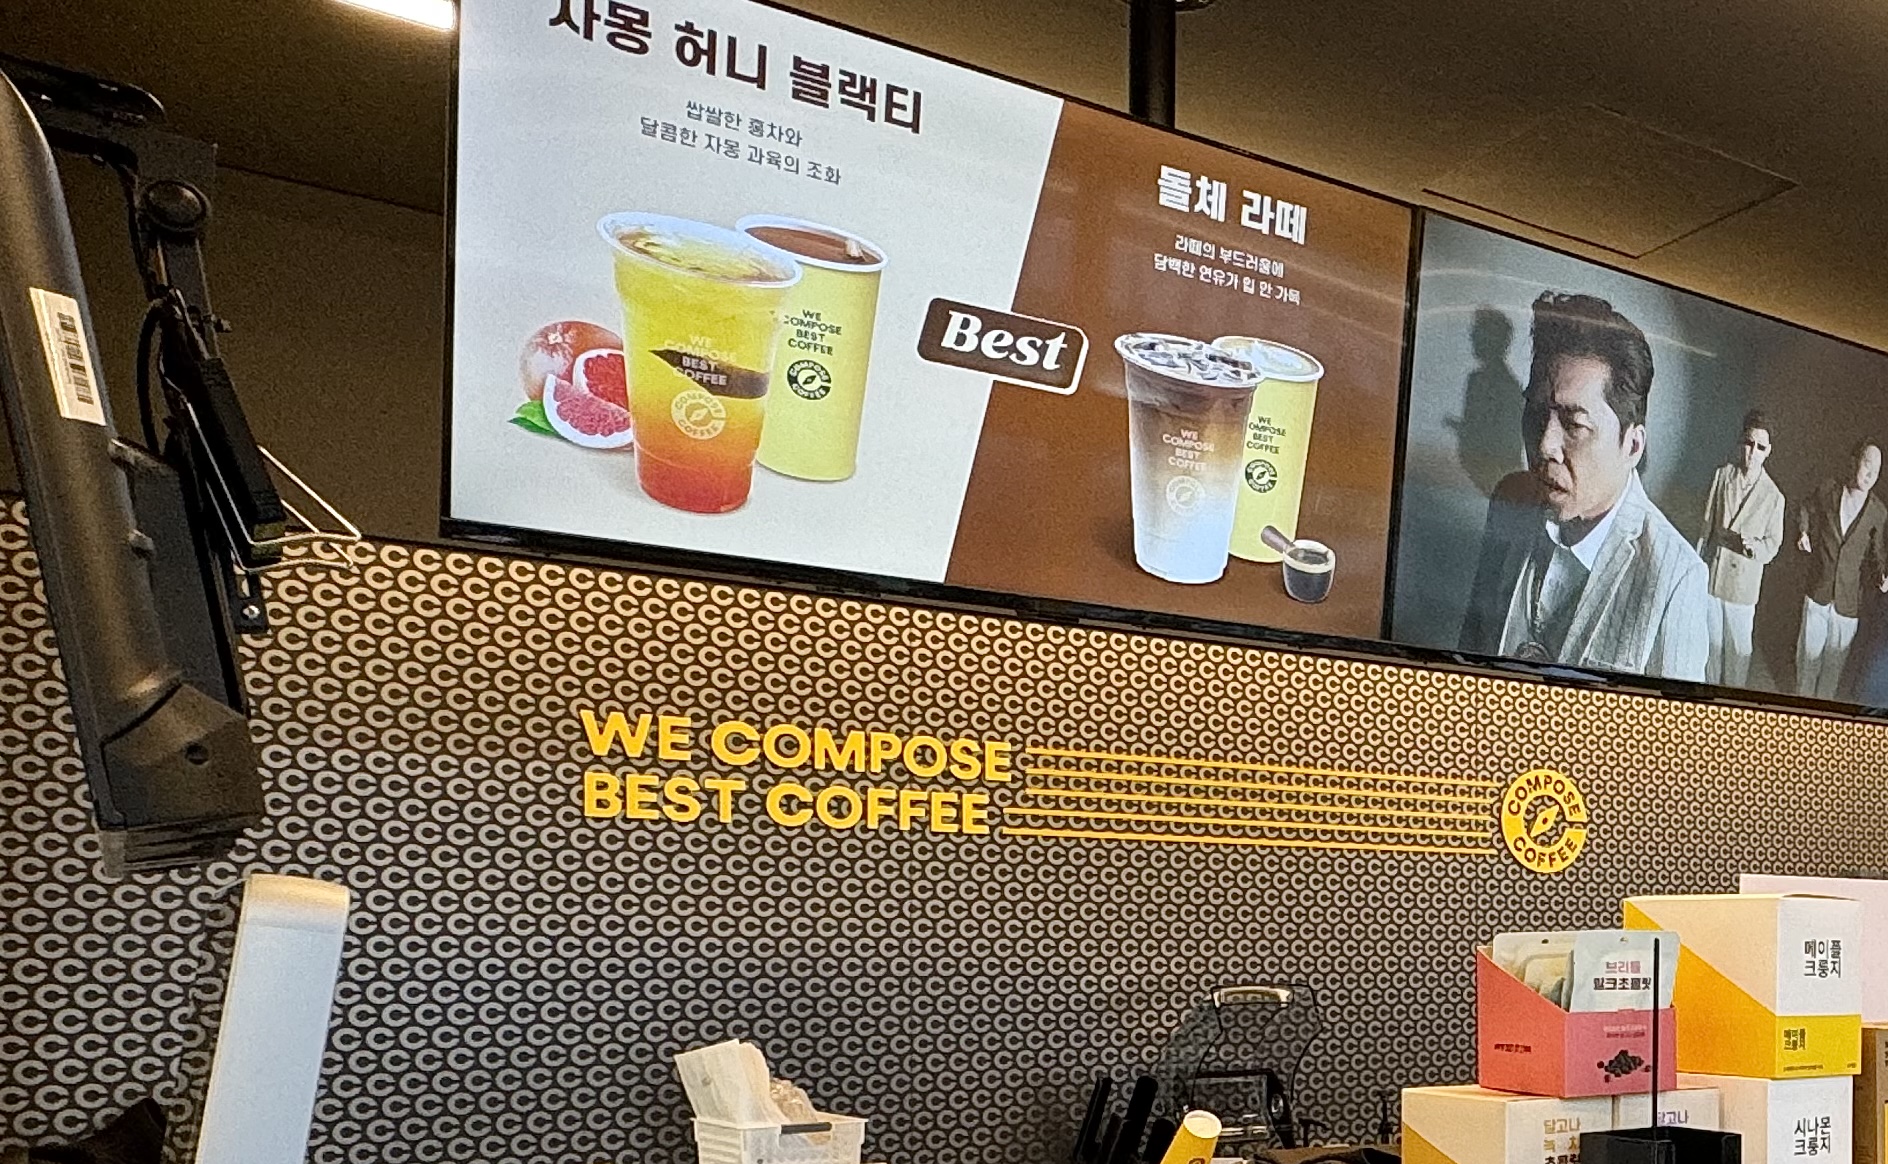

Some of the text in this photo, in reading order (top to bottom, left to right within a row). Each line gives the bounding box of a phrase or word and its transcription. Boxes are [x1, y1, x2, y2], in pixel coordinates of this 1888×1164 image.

[674, 20, 767, 91] 허니
[789, 54, 922, 134] 블랙티
[686, 100, 803, 149] 쌉쌀한 홍차와
[640, 116, 841, 185] 달콤한 자몽 과육의 조화
[1158, 163, 1308, 245] 돌체 라떼
[802, 309, 822, 321] WE
[788, 338, 834, 355] COFFEE
[796, 328, 826, 342] BEST
[941, 310, 1068, 372] Best
[682, 355, 717, 372] BEST
[580, 710, 1012, 782] WE COMPOSE
[584, 772, 990, 835] BEST COFFEE
[1508, 775, 1582, 816] COMPOSE
[1514, 837, 1578, 868] COFFEE
[1804, 938, 1842, 959] 메이플
[1804, 957, 1841, 978] 크룽지
[1543, 1117, 1580, 1135] 달고나
[1794, 1116, 1831, 1137] 시나몬
[1794, 1135, 1831, 1156] 크룽지
